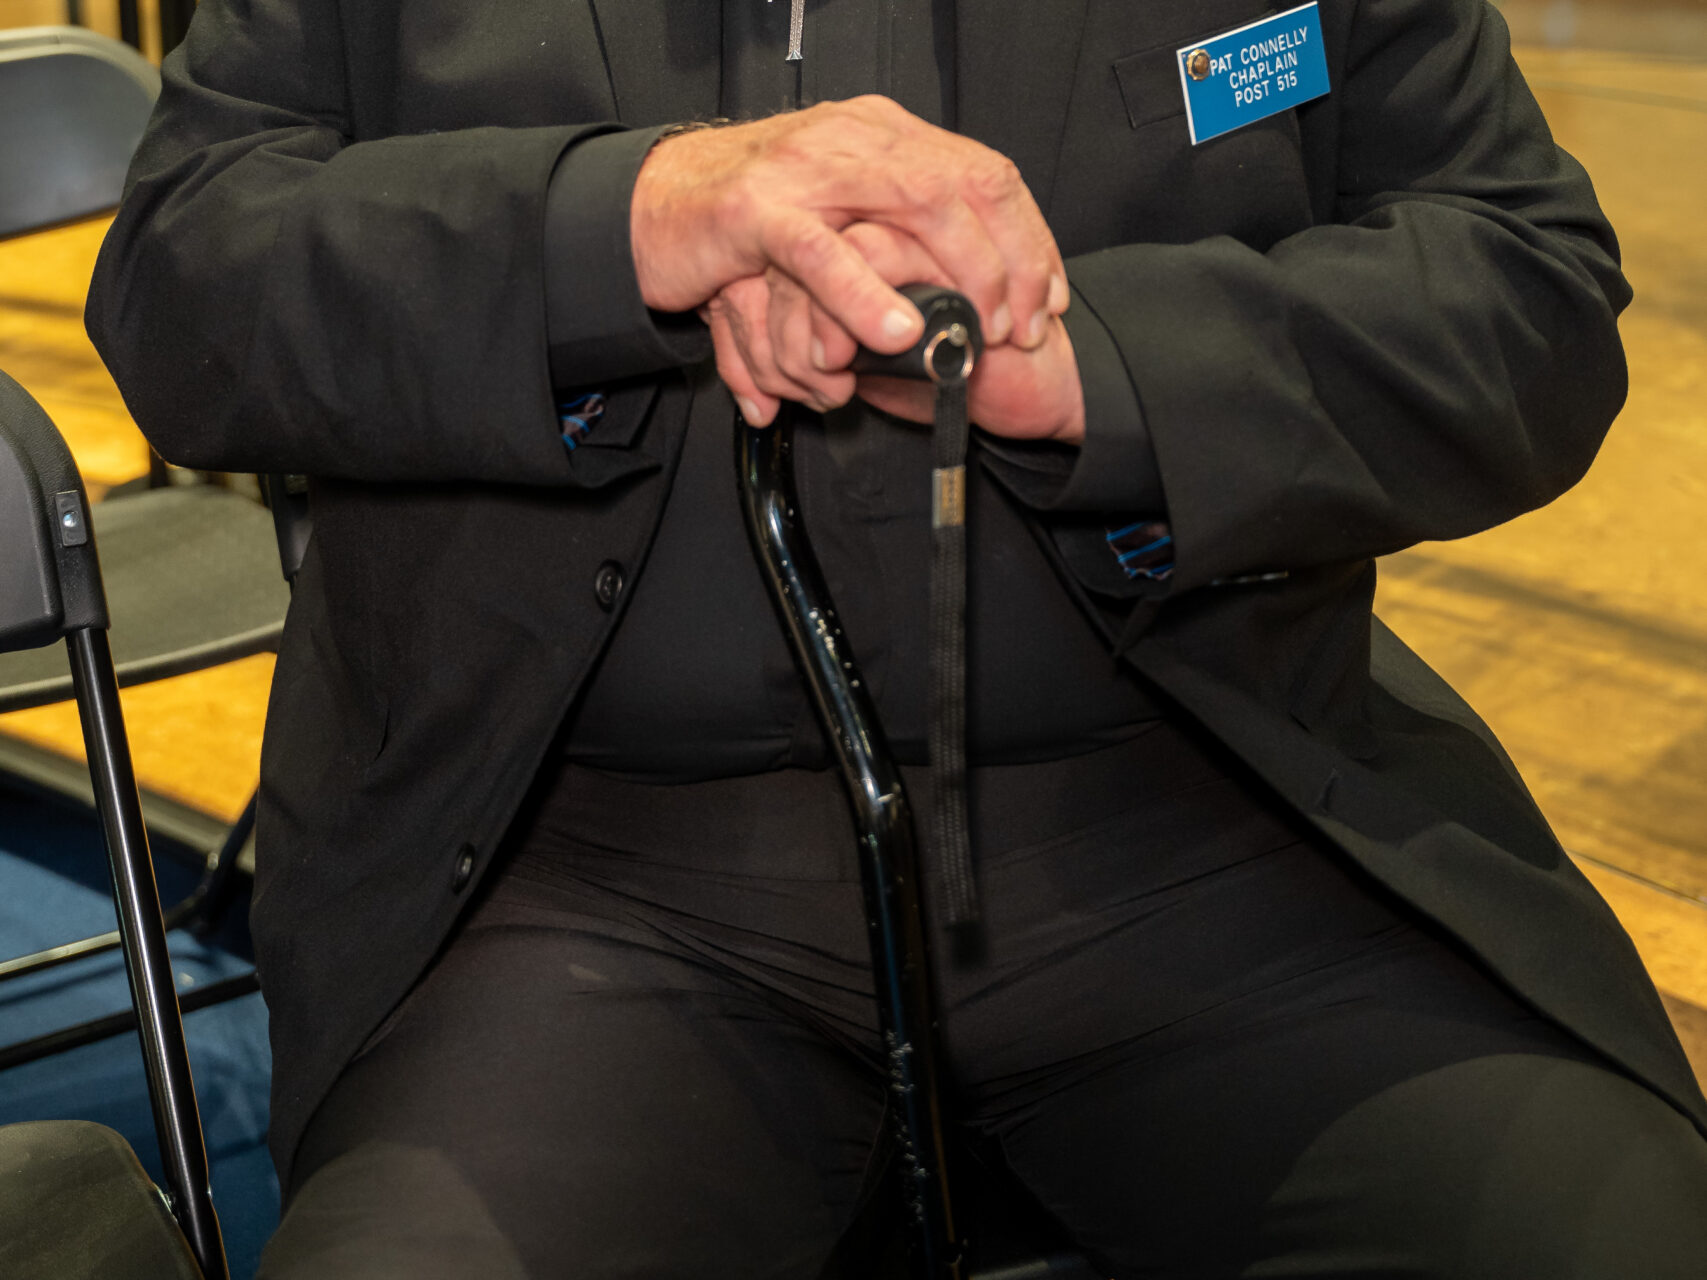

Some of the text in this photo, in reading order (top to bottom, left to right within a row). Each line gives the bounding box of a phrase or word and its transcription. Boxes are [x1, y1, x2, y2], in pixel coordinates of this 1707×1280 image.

[1210, 26, 1308, 76] PAT CONNELLY
[1229, 50, 1298, 89] CHAPLAIN
[1235, 71, 1298, 108] POST 515
